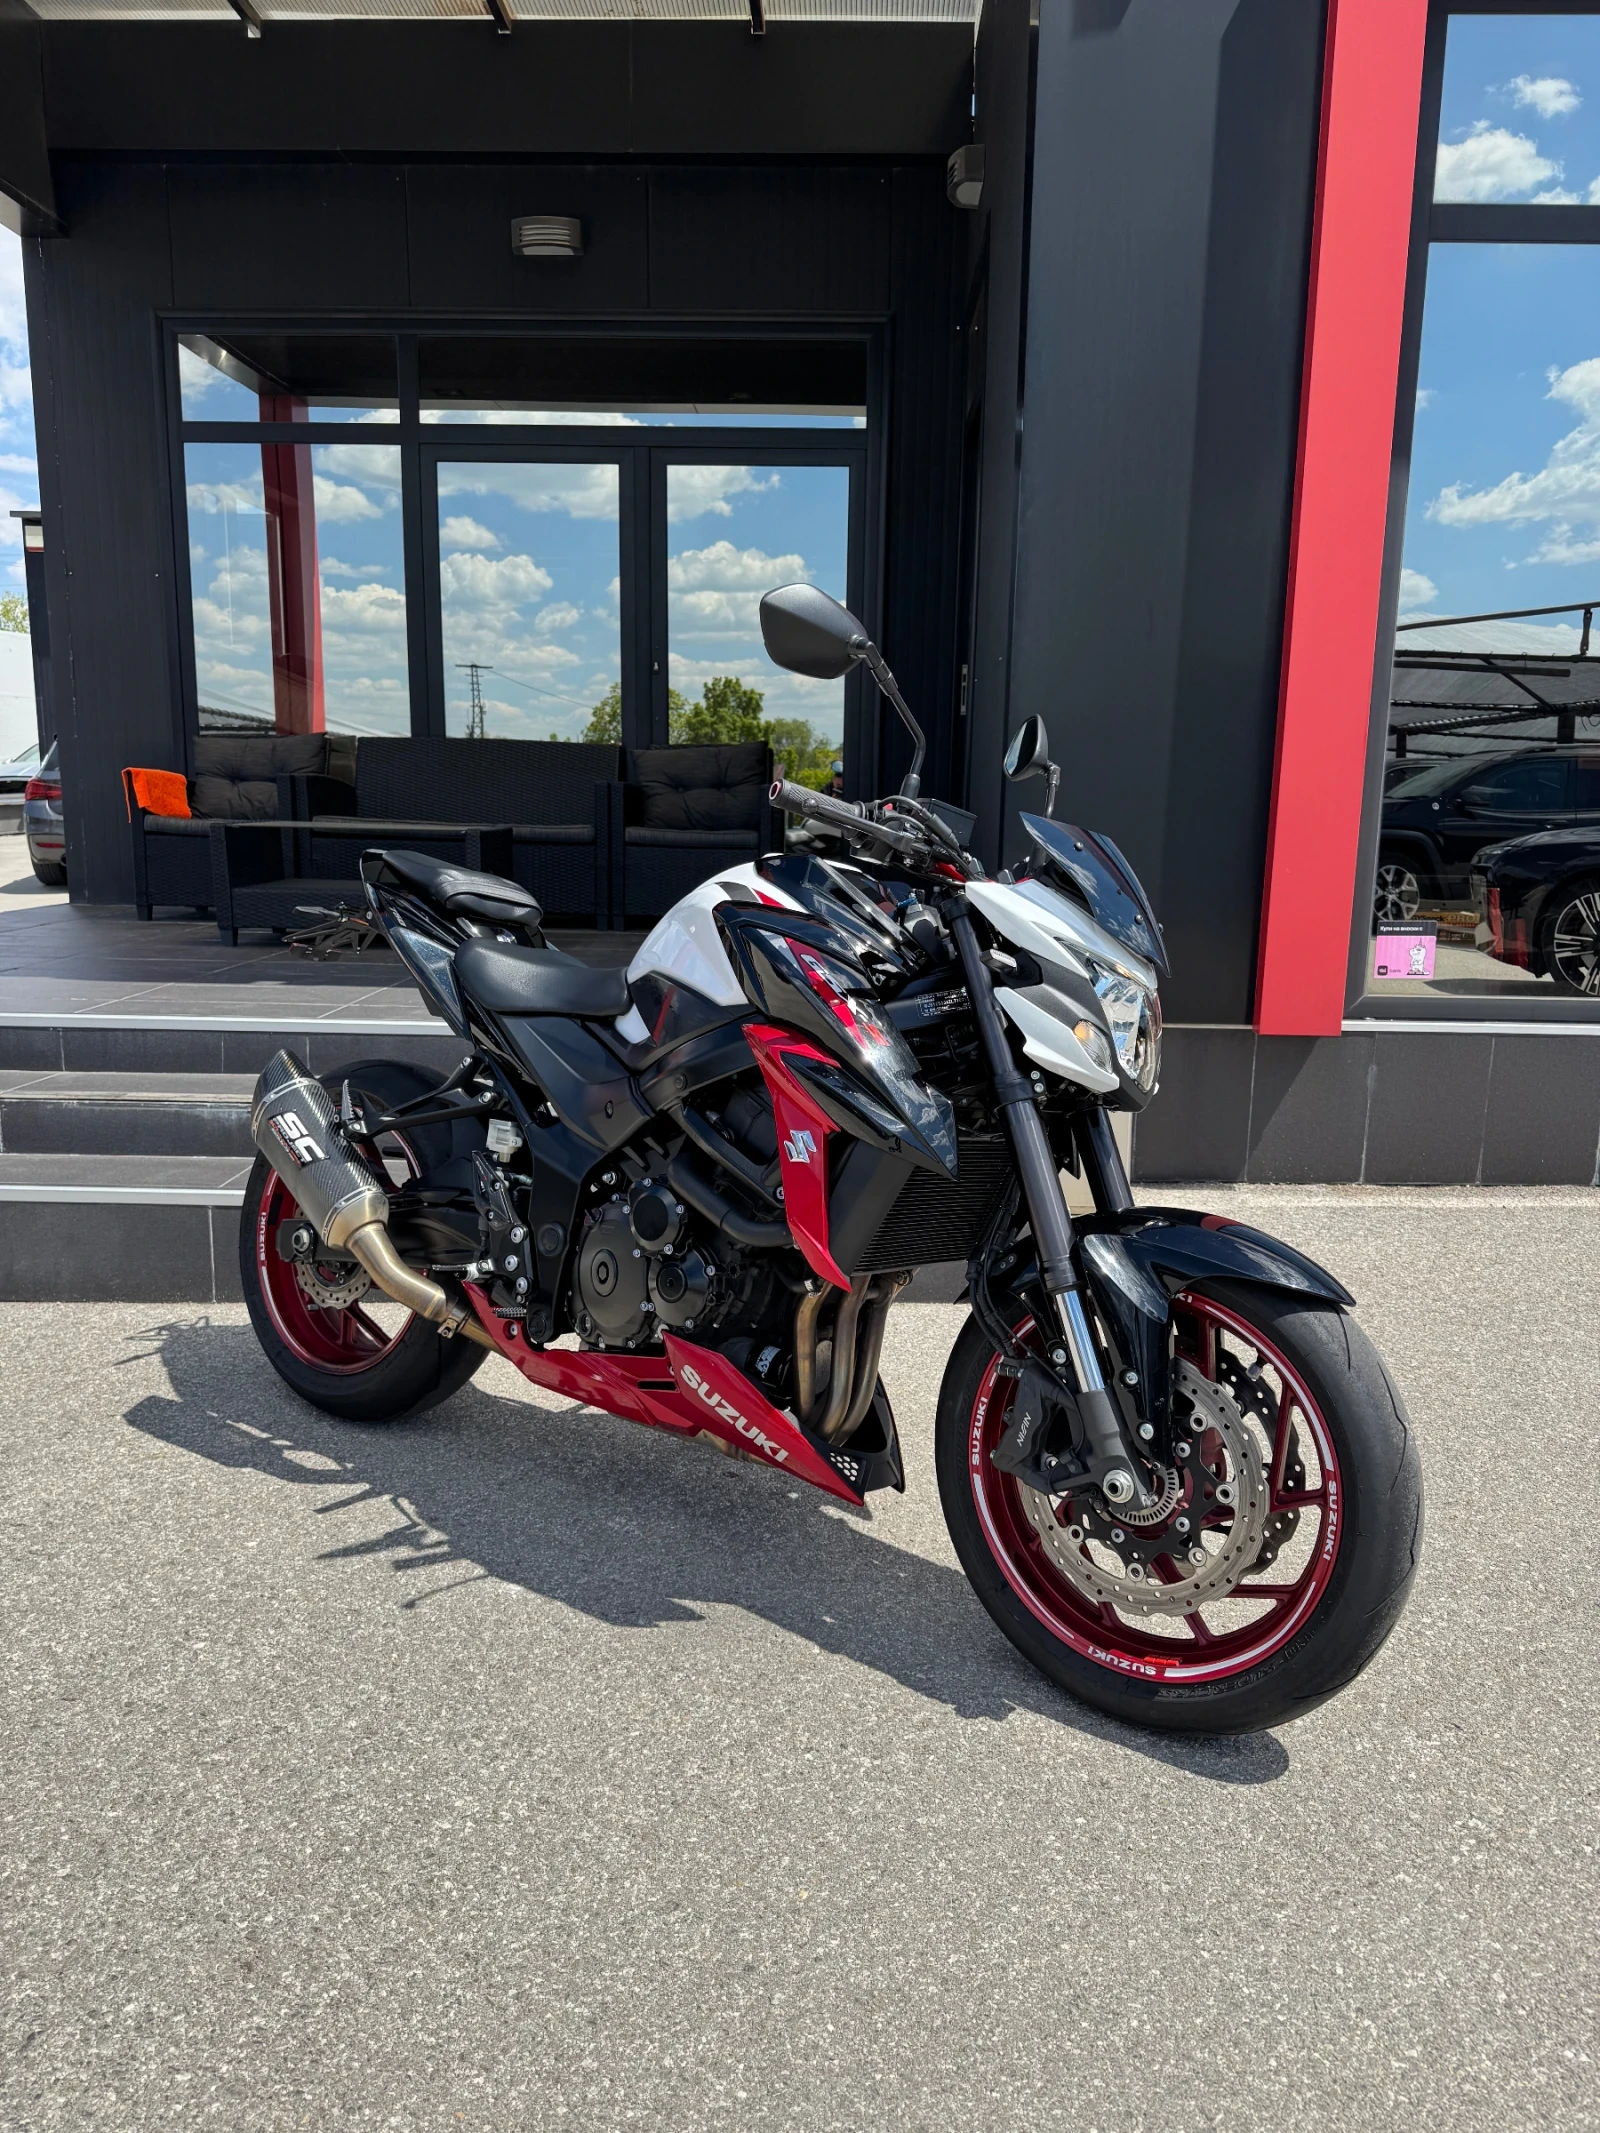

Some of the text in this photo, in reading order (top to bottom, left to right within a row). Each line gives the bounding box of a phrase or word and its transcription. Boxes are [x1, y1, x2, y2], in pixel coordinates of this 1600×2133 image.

[276, 1112, 326, 1162] SC
[259, 1212, 267, 1261] SUZUKI
[680, 1364, 789, 1463] SUZUKI
[972, 1397, 988, 1466] SUZUKI
[1323, 1480, 1338, 1561] SUZUKI
[1087, 1645, 1157, 1675] SUZUKI
